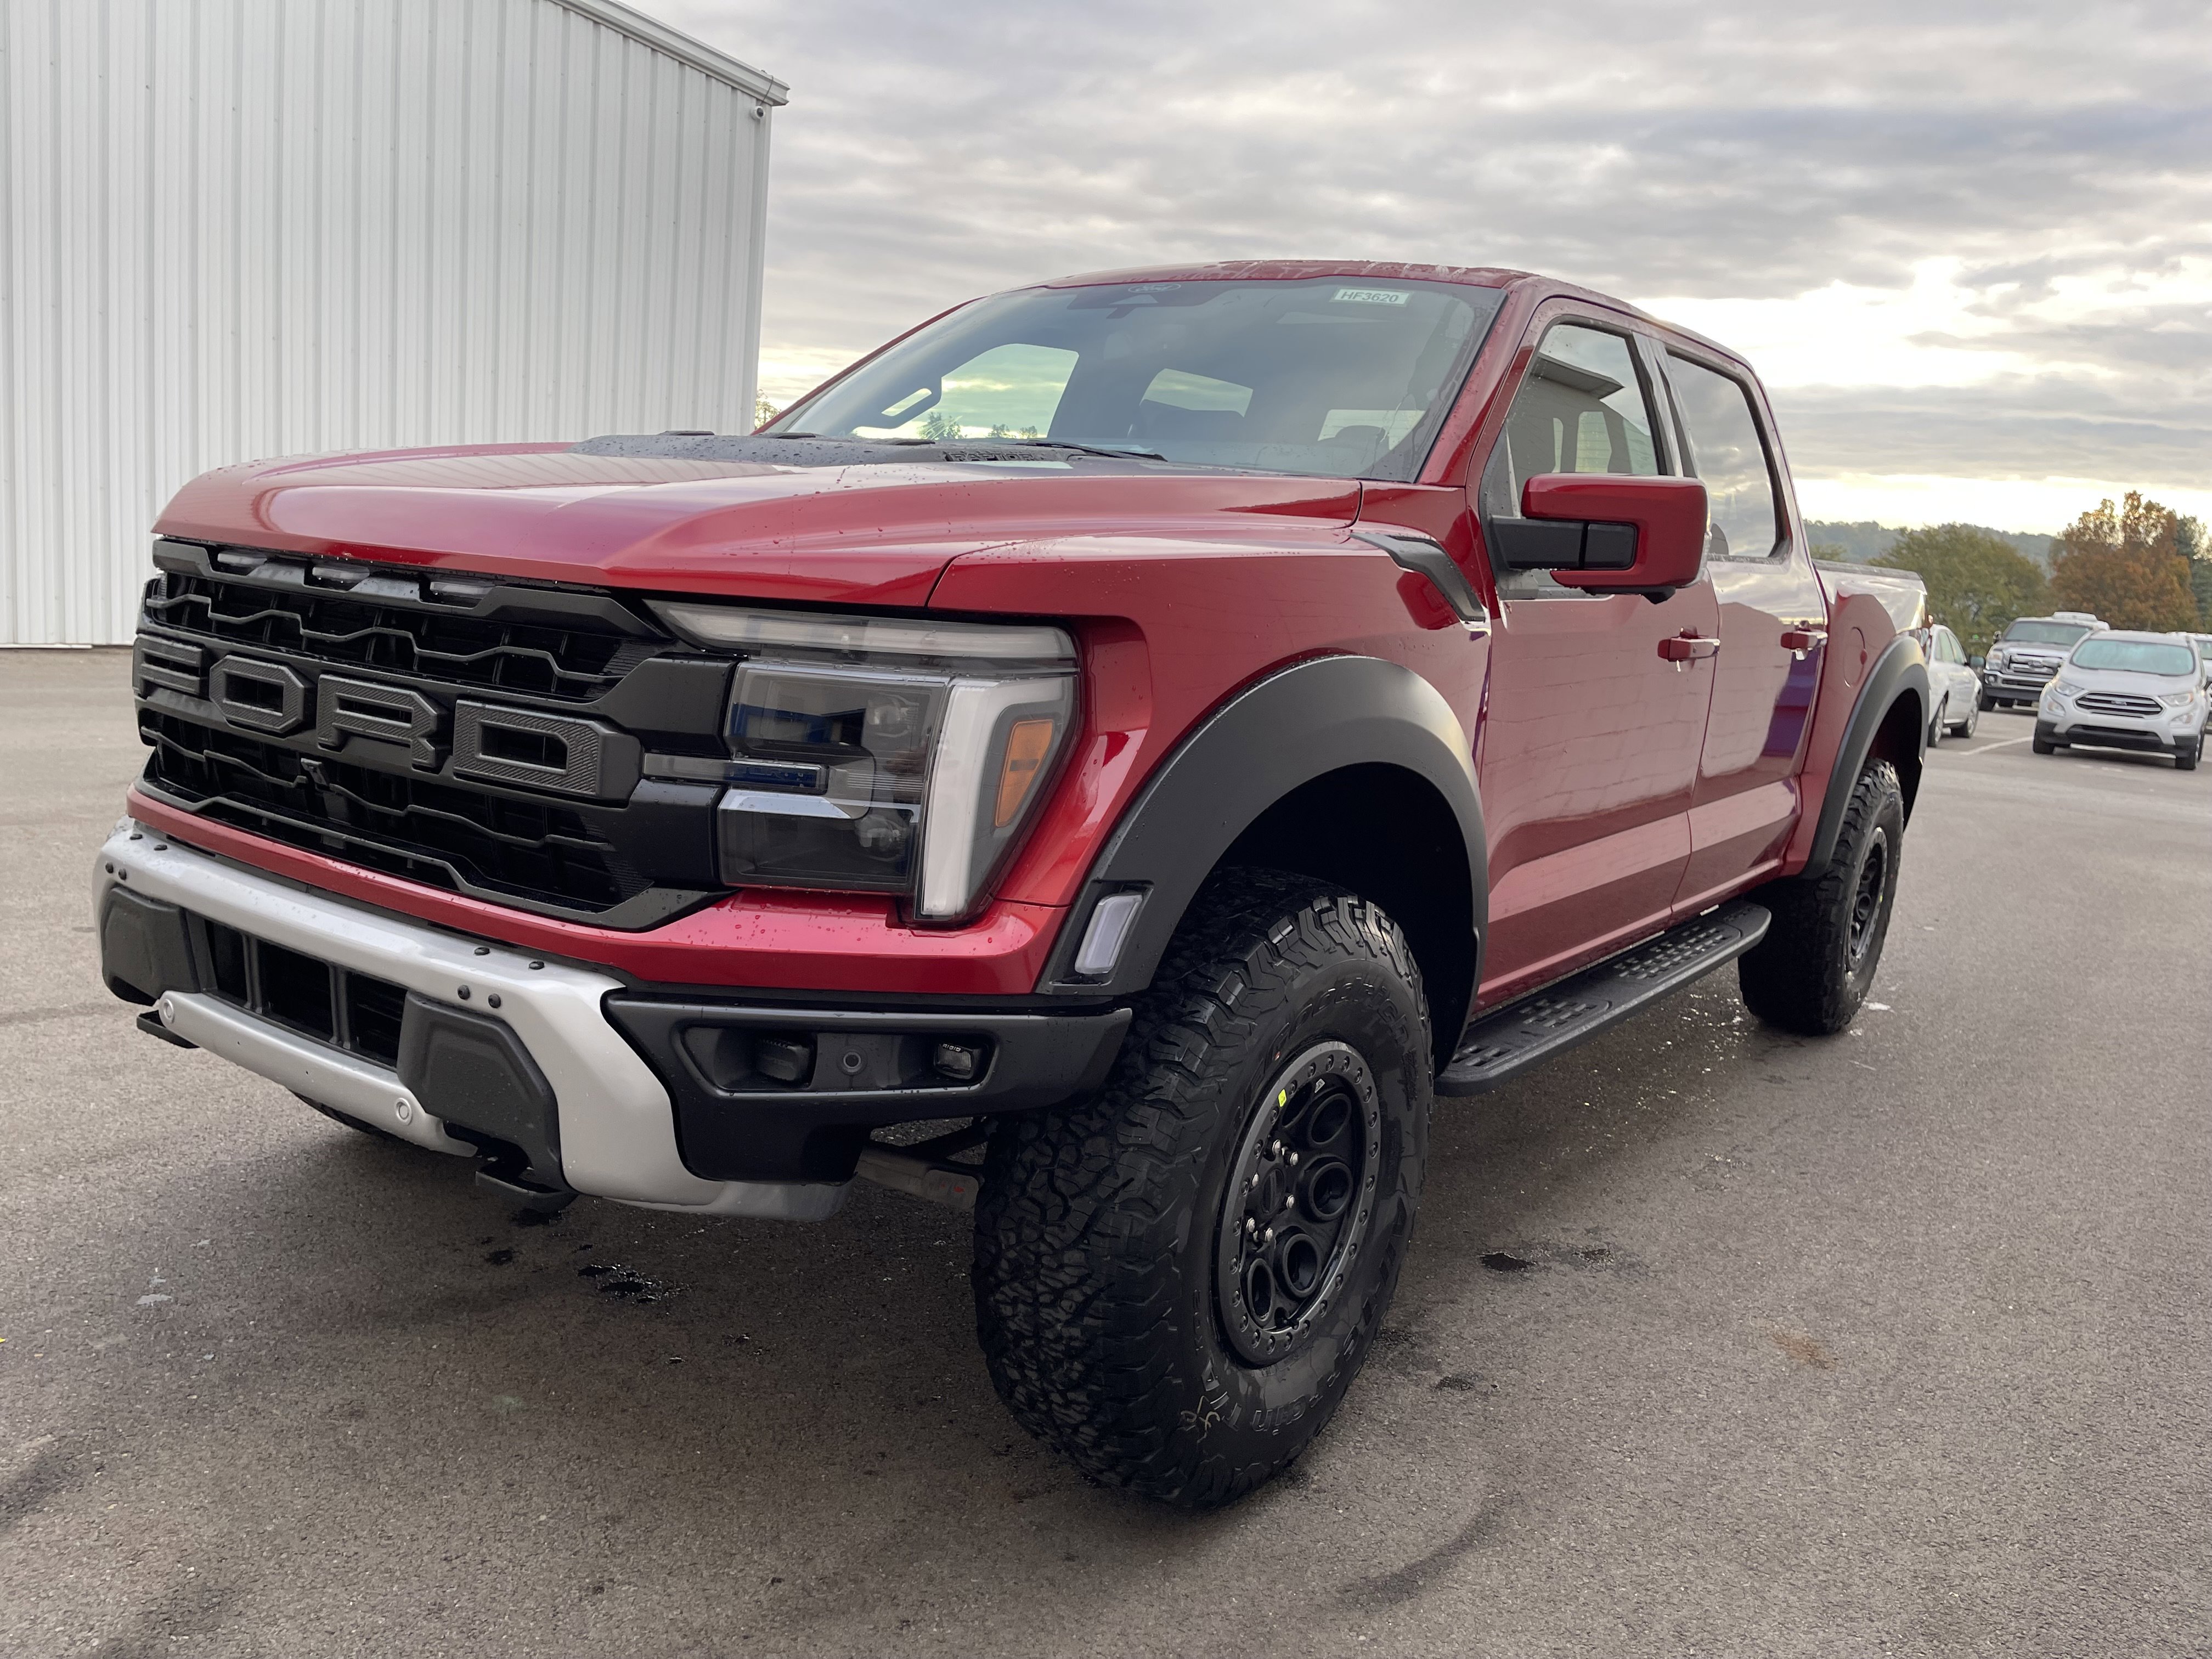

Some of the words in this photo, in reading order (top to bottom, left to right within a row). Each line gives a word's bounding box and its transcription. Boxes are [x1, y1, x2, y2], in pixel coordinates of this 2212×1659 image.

[1341, 291, 1400, 303] HF3620
[945, 451, 1035, 462] RAPTOR
[132, 633, 628, 801] FORD
[942, 1043, 962, 1052] RIGID
